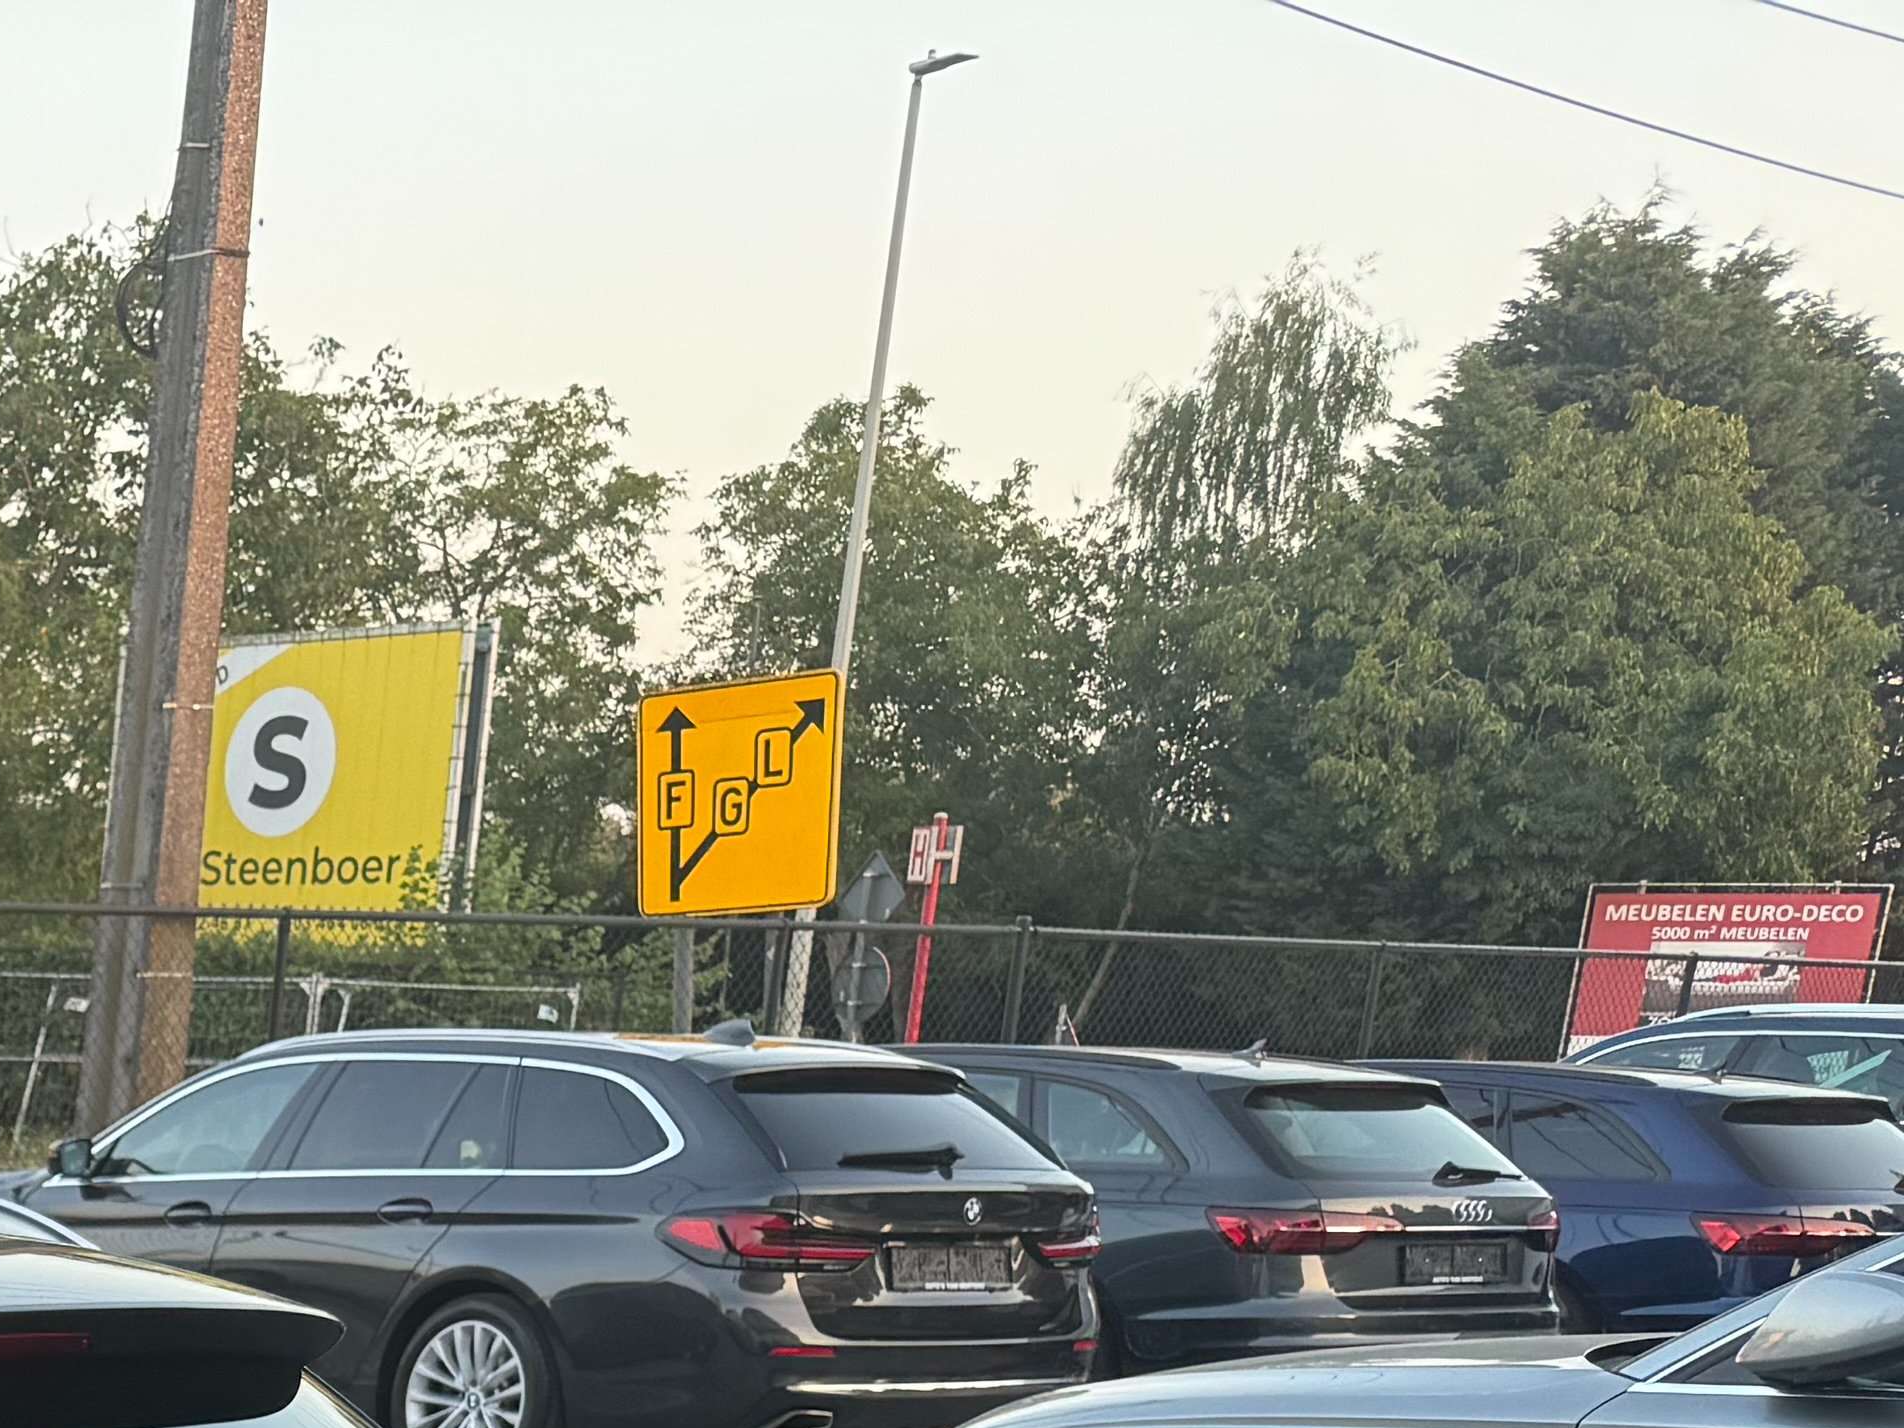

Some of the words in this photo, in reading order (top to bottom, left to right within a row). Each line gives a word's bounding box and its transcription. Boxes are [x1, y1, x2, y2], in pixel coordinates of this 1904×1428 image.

[248, 714, 309, 810] S
[764, 739, 783, 778] L
[666, 780, 686, 820] F
[720, 787, 743, 826] G
[200, 846, 401, 887] Steenboer
[1605, 904, 1726, 922] MEUBELEN
[1731, 904, 1864, 923] EURO-DECO
[1651, 926, 1691, 940] 5000
[1720, 927, 1809, 941] MEUBELEN
